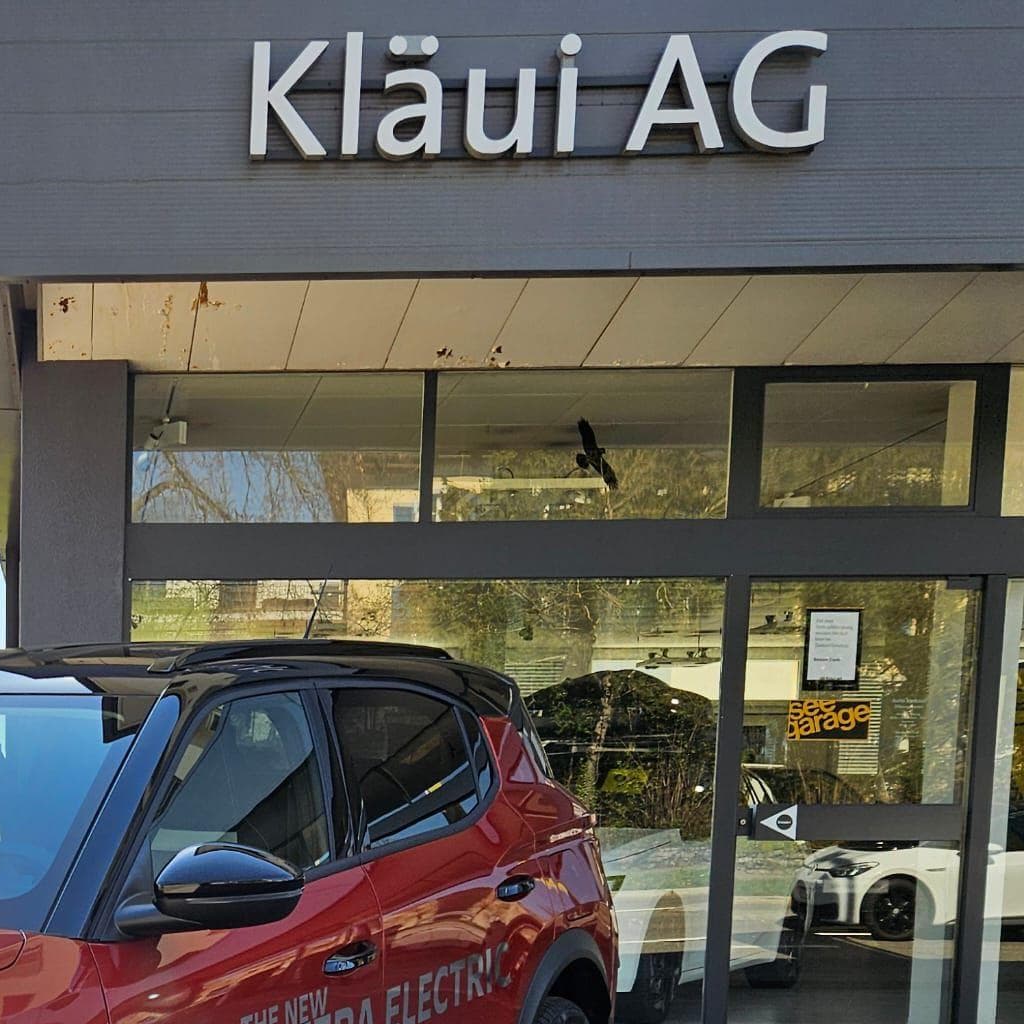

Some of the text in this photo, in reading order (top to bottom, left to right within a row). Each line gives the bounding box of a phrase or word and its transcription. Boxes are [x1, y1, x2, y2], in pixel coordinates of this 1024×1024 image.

[248, 29, 829, 160] Kläui AG
[788, 704, 871, 741] garage
[789, 699, 837, 721] see
